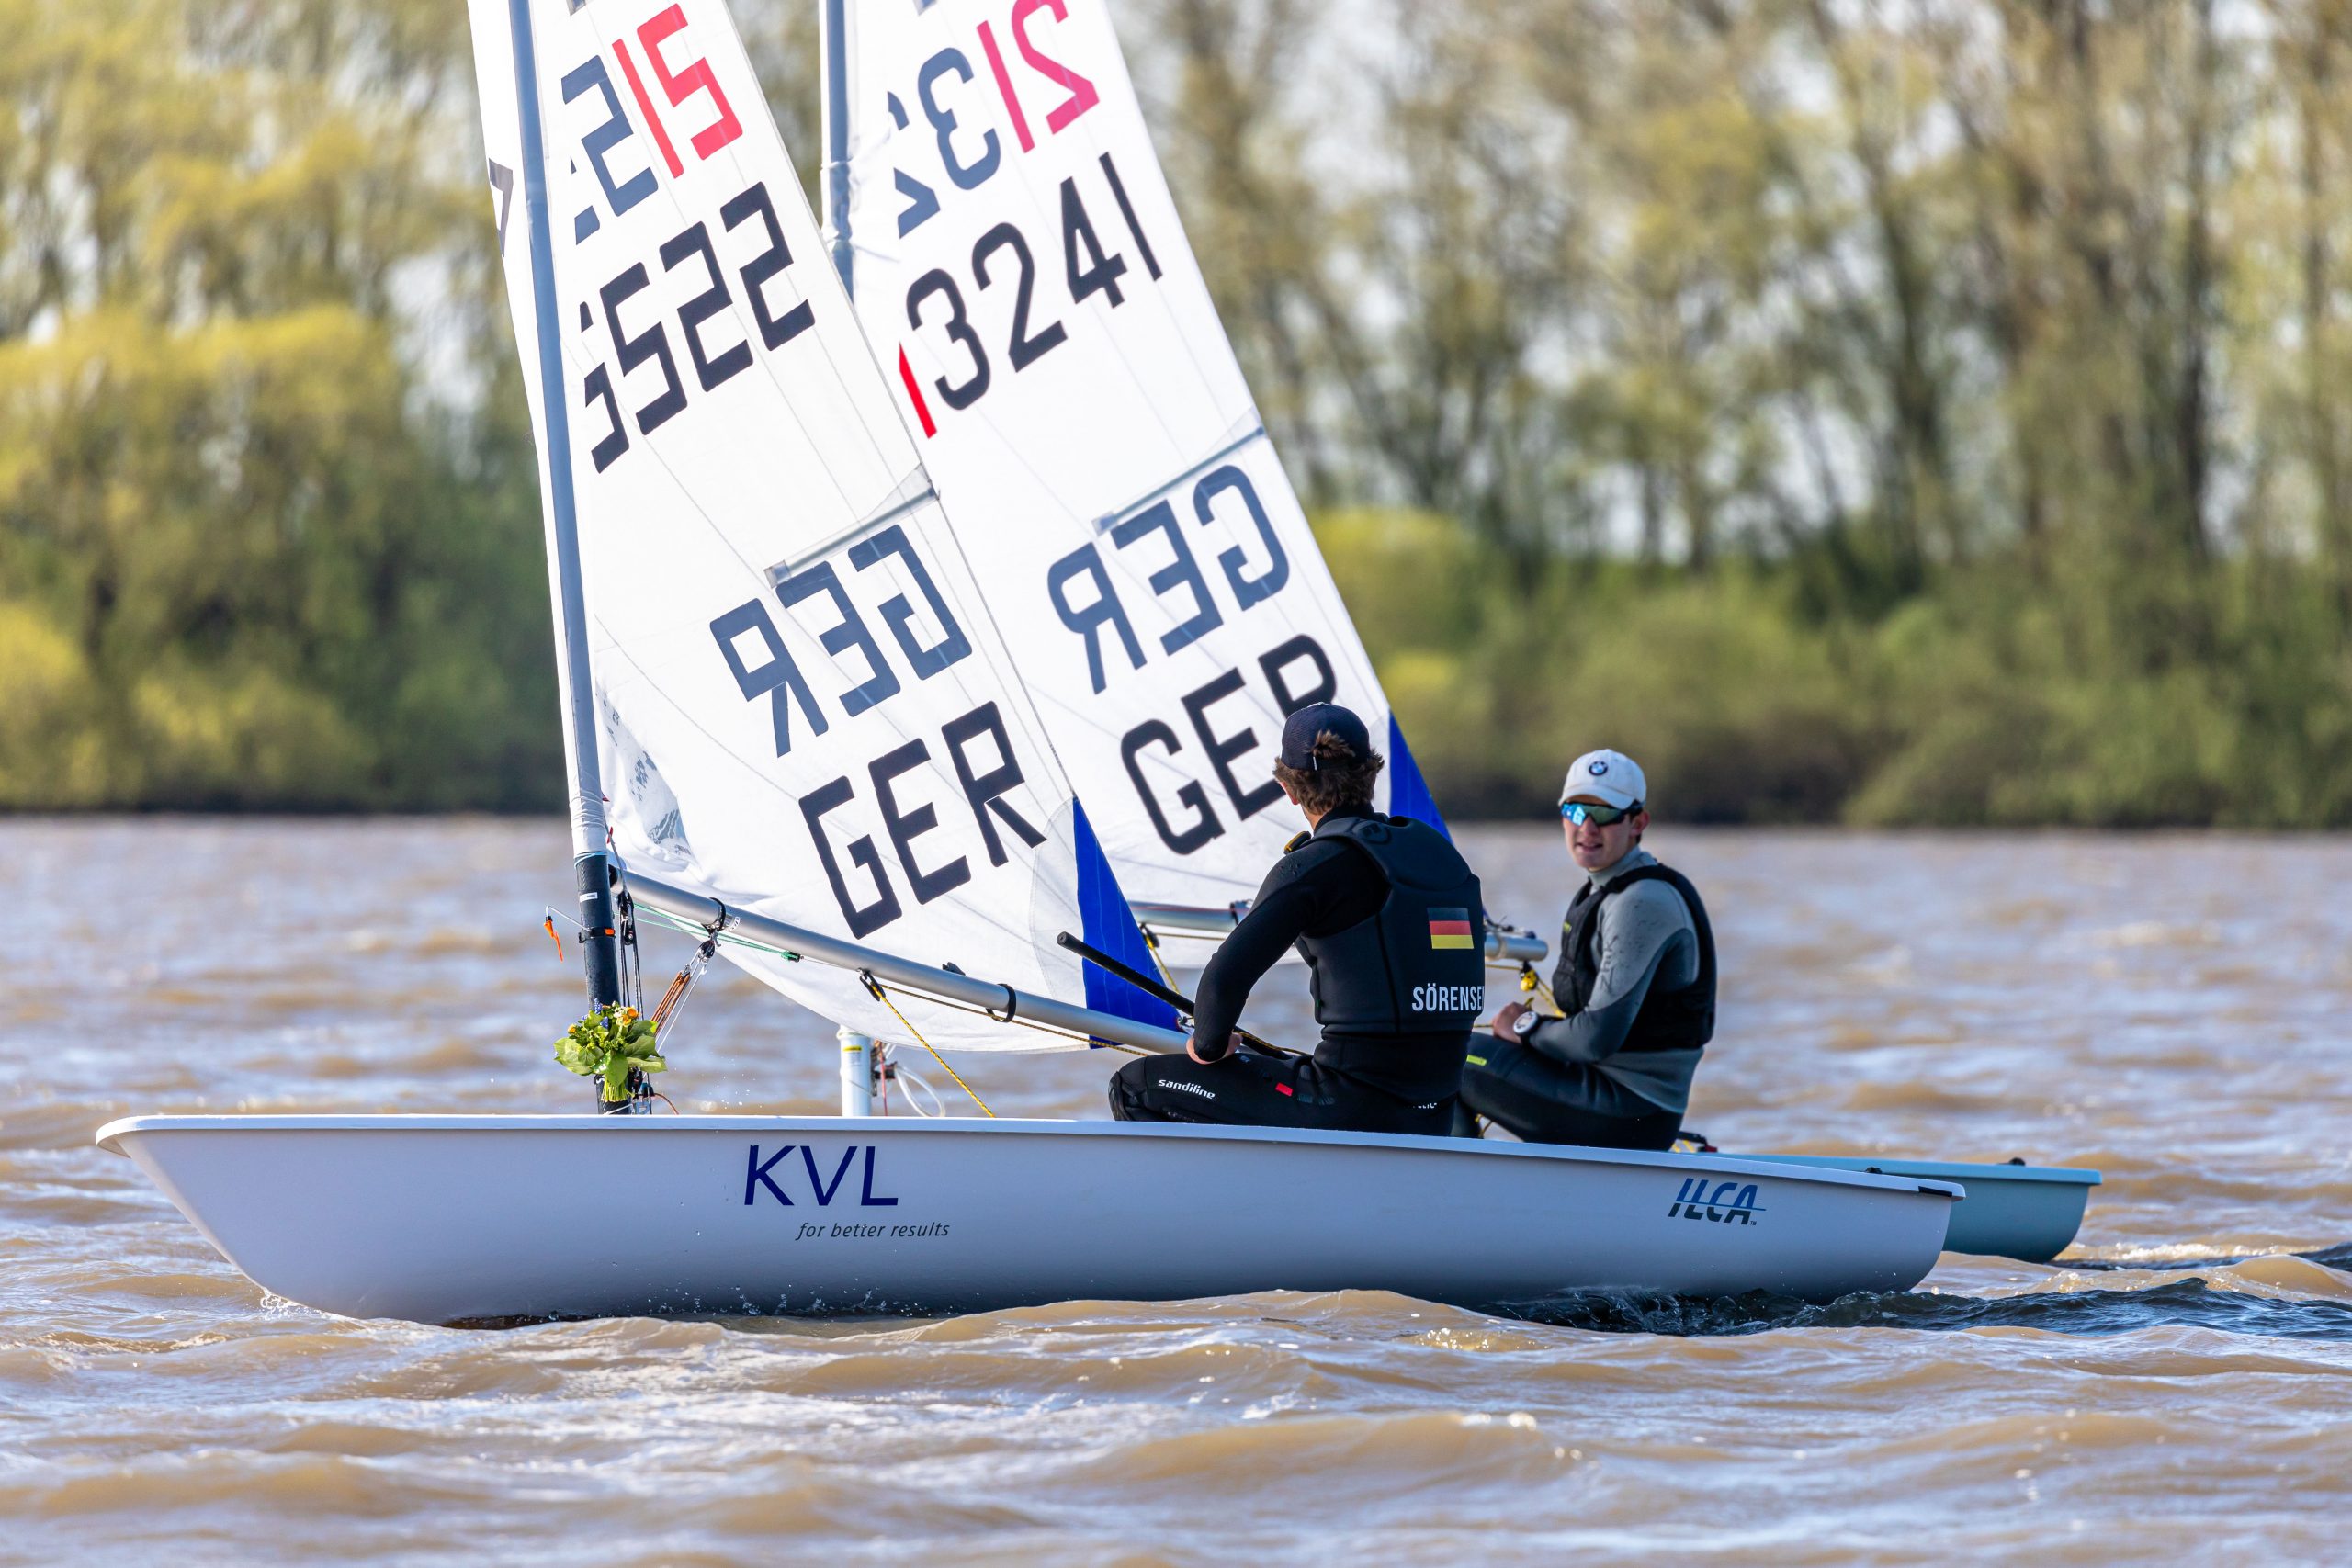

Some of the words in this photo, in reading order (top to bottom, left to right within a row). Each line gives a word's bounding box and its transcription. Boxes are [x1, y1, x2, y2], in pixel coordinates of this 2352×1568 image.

[798, 701, 1047, 940] GER
[1158, 1078, 1216, 1100] sandiline
[744, 1145, 899, 1206] KVL
[1668, 1177, 1761, 1225] ILCA
[795, 1222, 826, 1241] for
[831, 1222, 886, 1238] better
[890, 1221, 951, 1238] results
